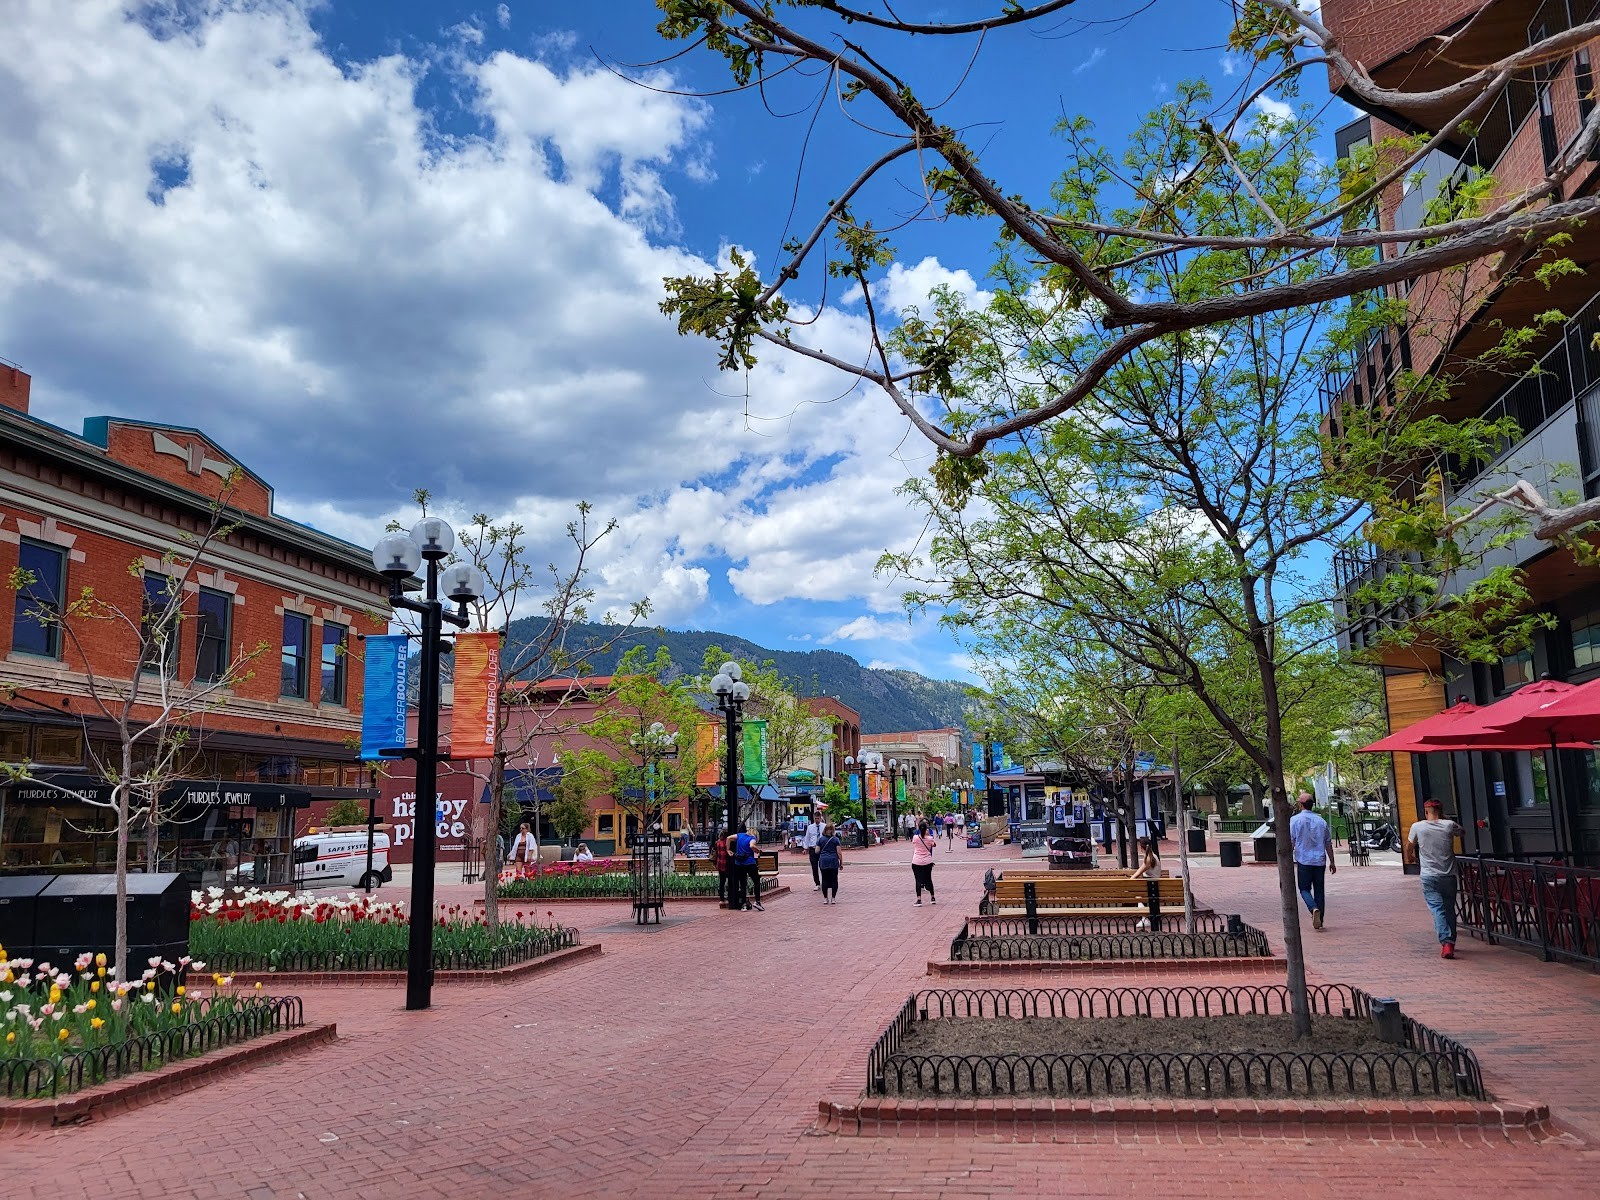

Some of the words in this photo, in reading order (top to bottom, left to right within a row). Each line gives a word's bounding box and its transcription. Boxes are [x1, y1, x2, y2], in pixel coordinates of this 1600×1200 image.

[396, 644, 407, 744] BOLDERBOULDER
[485, 648, 498, 745] BOLDERBOULDER
[187, 791, 220, 804] HURDLE'S
[222, 792, 252, 805] JEWELRY
[392, 797, 468, 820] hapy
[393, 818, 465, 846] plce
[347, 842, 376, 850] SYSTES
